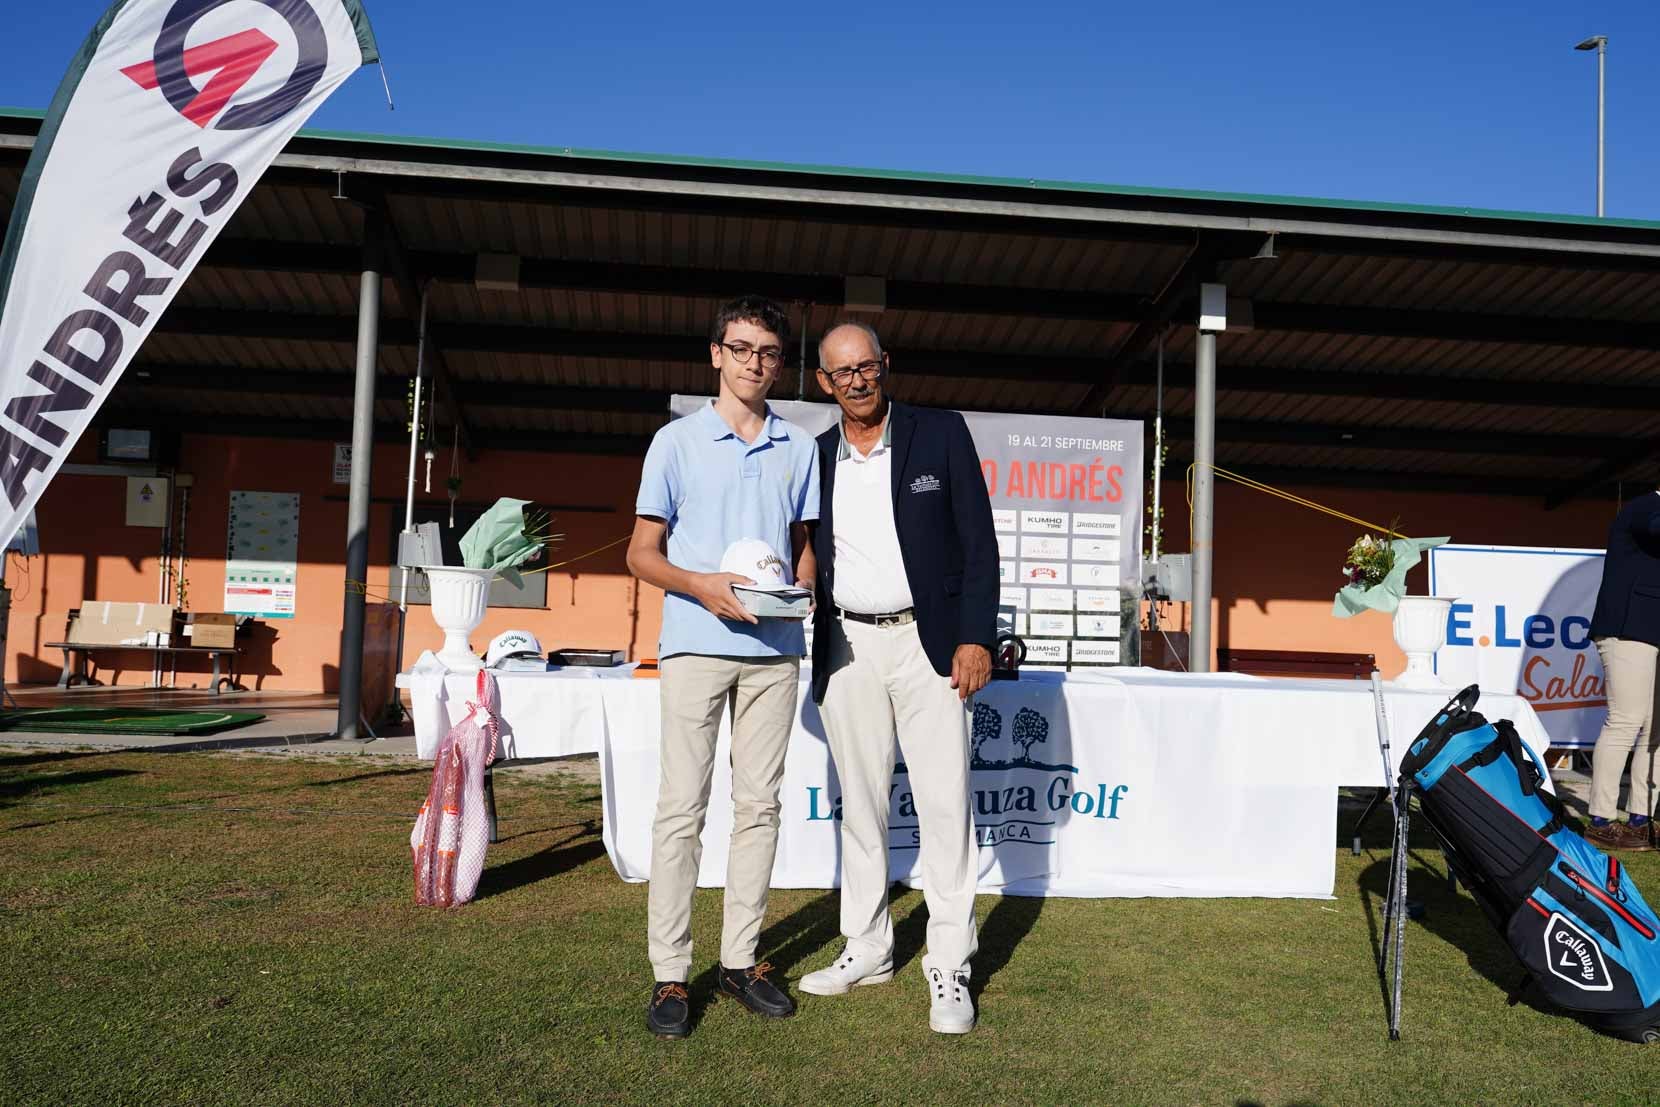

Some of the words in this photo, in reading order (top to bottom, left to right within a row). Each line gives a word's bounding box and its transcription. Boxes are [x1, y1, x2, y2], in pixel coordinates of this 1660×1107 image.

[0, 146, 239, 512] ANDRÉS
[1008, 434, 1020, 447] 19
[1023, 435, 1038, 447] AL
[1040, 436, 1052, 448] 21
[1055, 437, 1125, 452] SEPTIEMBRE
[1005, 456, 1124, 503] ANDRÉS
[1027, 516, 1063, 524] KUMHO
[1446, 603, 1592, 650] E.Lec
[1516, 652, 1606, 700] Sala
[1047, 776, 1128, 819] Golf
[1555, 930, 1595, 980] Callaway
